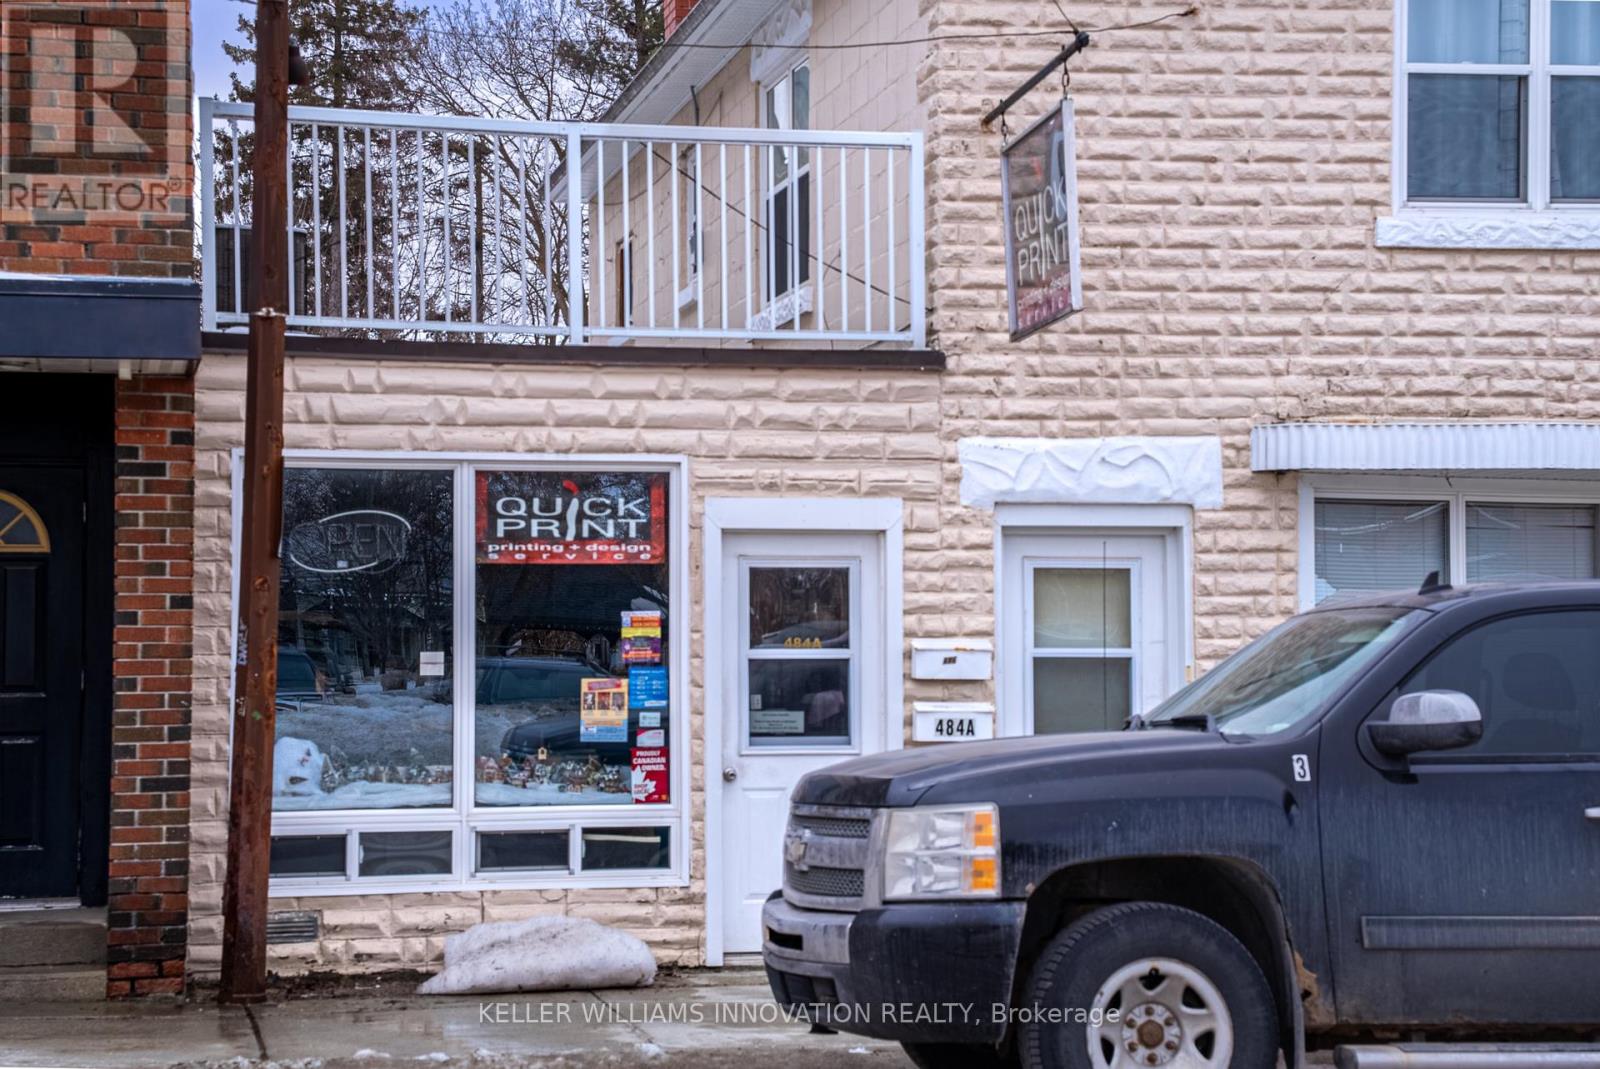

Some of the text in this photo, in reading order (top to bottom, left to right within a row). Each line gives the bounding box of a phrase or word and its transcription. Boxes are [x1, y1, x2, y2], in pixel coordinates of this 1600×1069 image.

[1015, 177, 1067, 241] QUICK
[1018, 222, 1068, 285] PRINT
[496, 481, 648, 517] QUICK
[496, 517, 648, 541] PRINT
[487, 543, 564, 553] printing
[585, 543, 651, 553] design
[935, 718, 975, 737] 484A
[1295, 757, 1307, 779] 3
